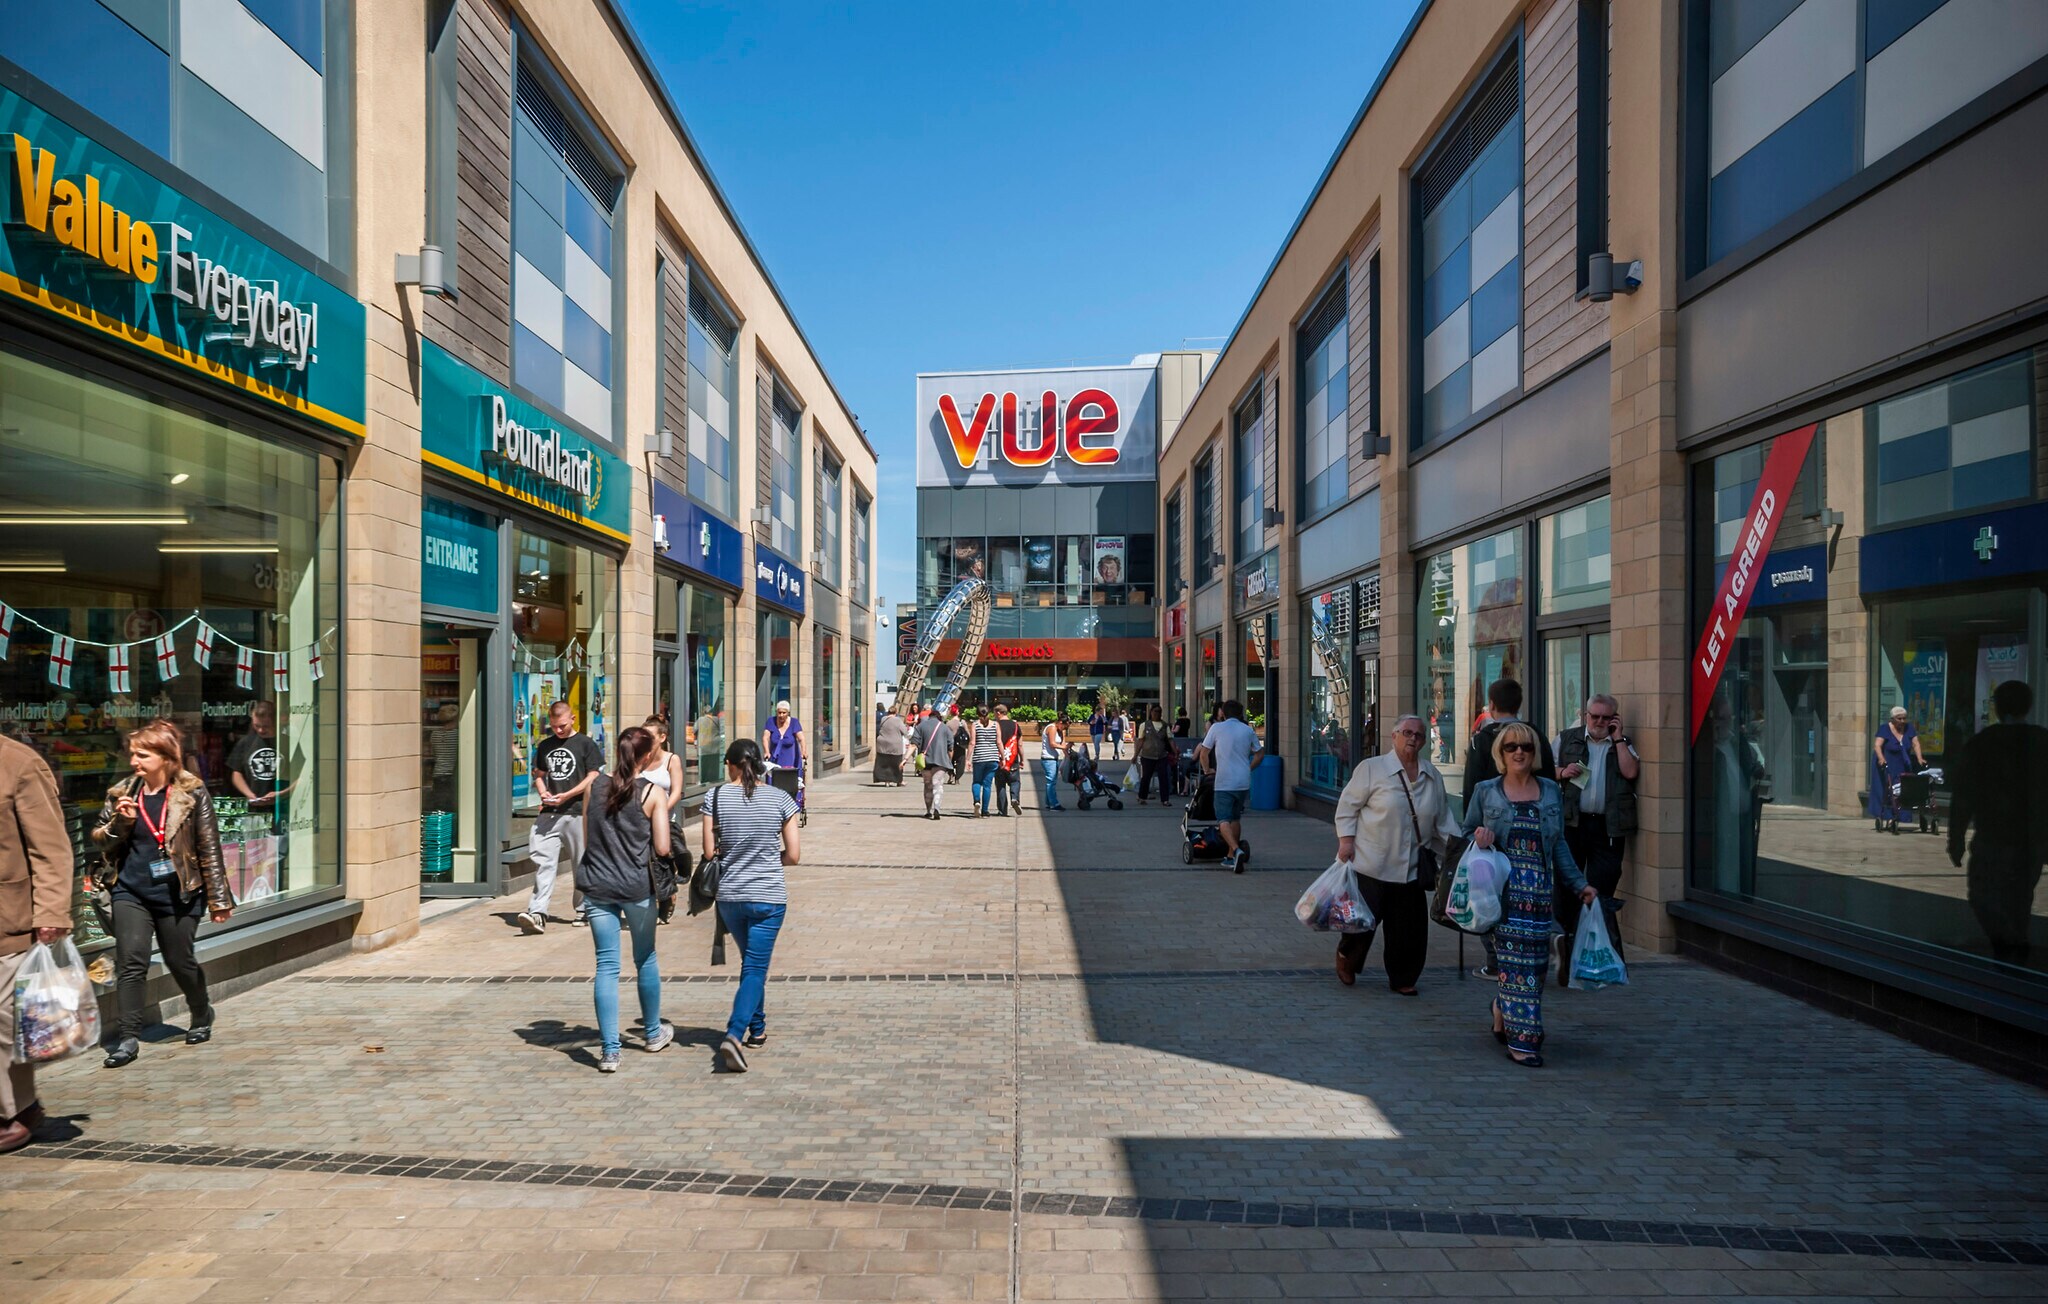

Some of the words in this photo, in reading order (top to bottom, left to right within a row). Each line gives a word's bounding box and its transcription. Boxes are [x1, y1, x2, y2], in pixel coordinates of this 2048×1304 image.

[14, 132, 158, 284] Value
[171, 222, 318, 371] Everyday!
[493, 395, 591, 497] Poundland
[425, 535, 479, 575] ENTRANCE
[1701, 615, 1725, 679] LET
[1724, 489, 1775, 620] AGREED
[988, 642, 1054, 658] Nando's
[104, 701, 160, 718] Poundland
[202, 701, 247, 717] Poundland
